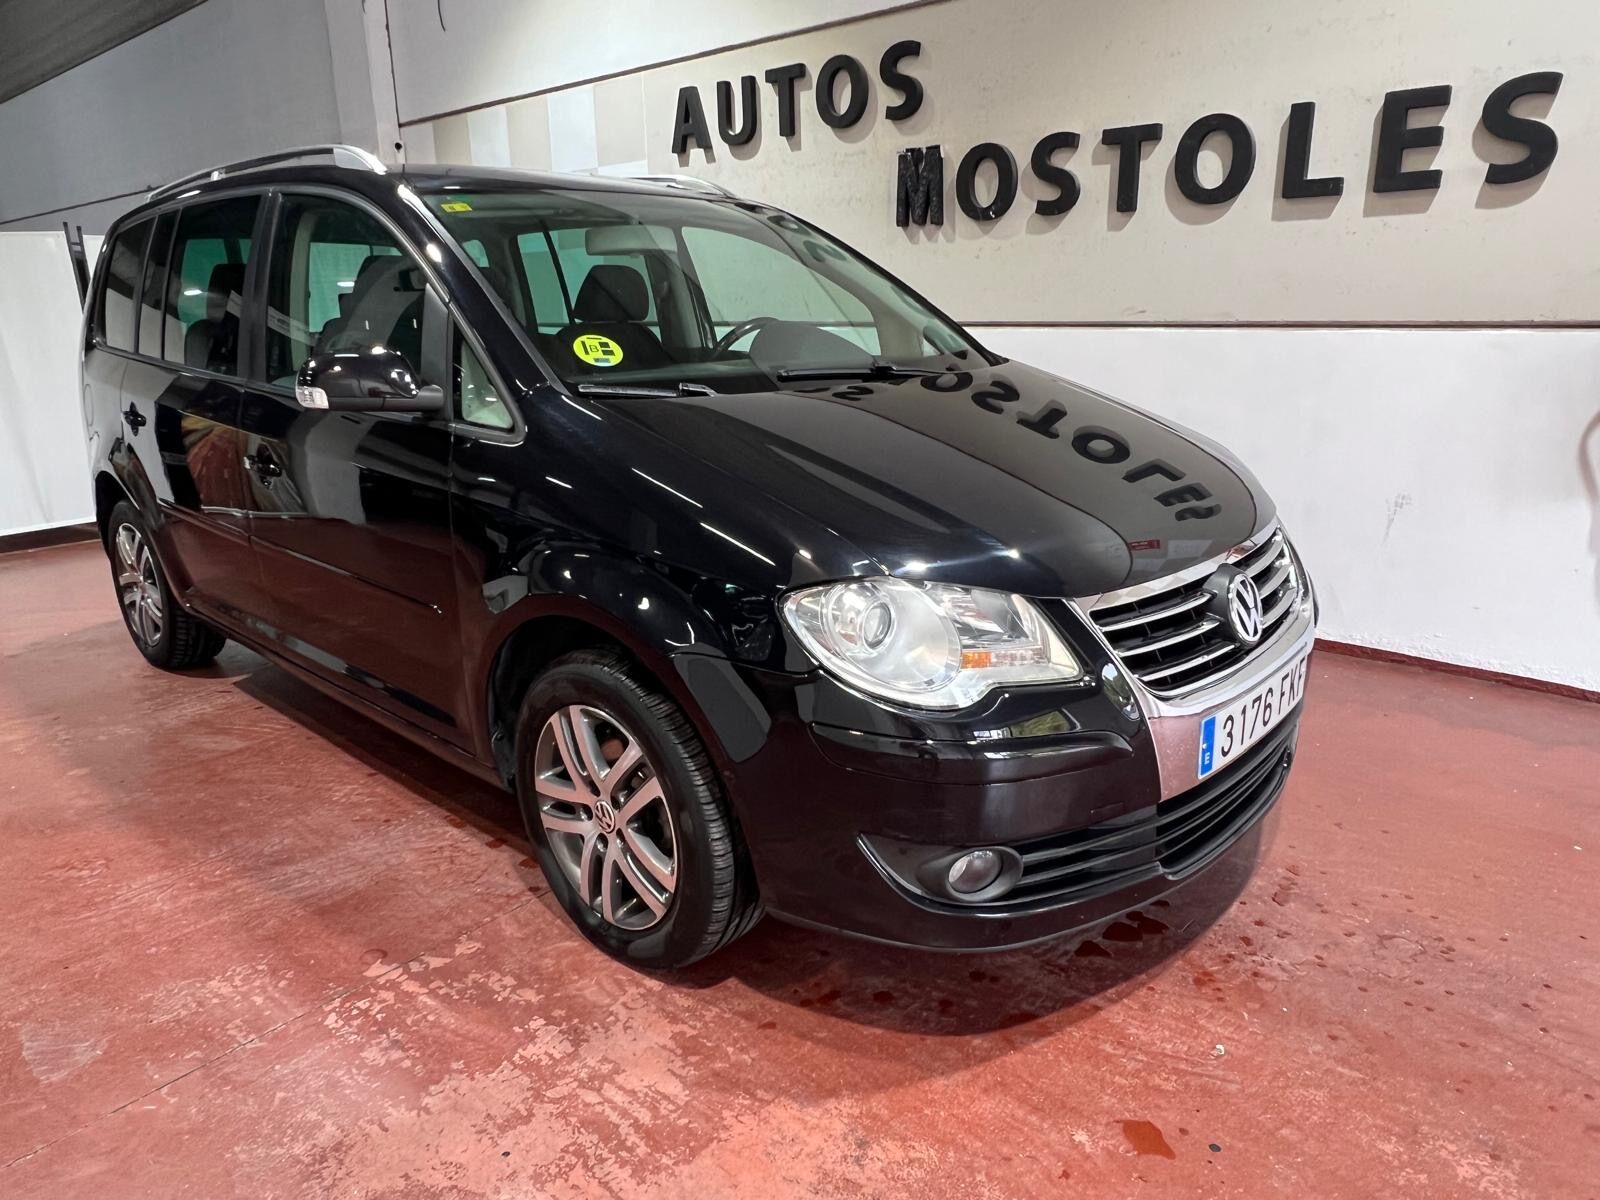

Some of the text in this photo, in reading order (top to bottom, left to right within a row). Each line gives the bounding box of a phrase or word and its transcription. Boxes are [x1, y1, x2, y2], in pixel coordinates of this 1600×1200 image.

[671, 40, 925, 156] AUTOS
[896, 71, 1564, 228] MOSTOLES
[1220, 687, 1275, 758] 3176
